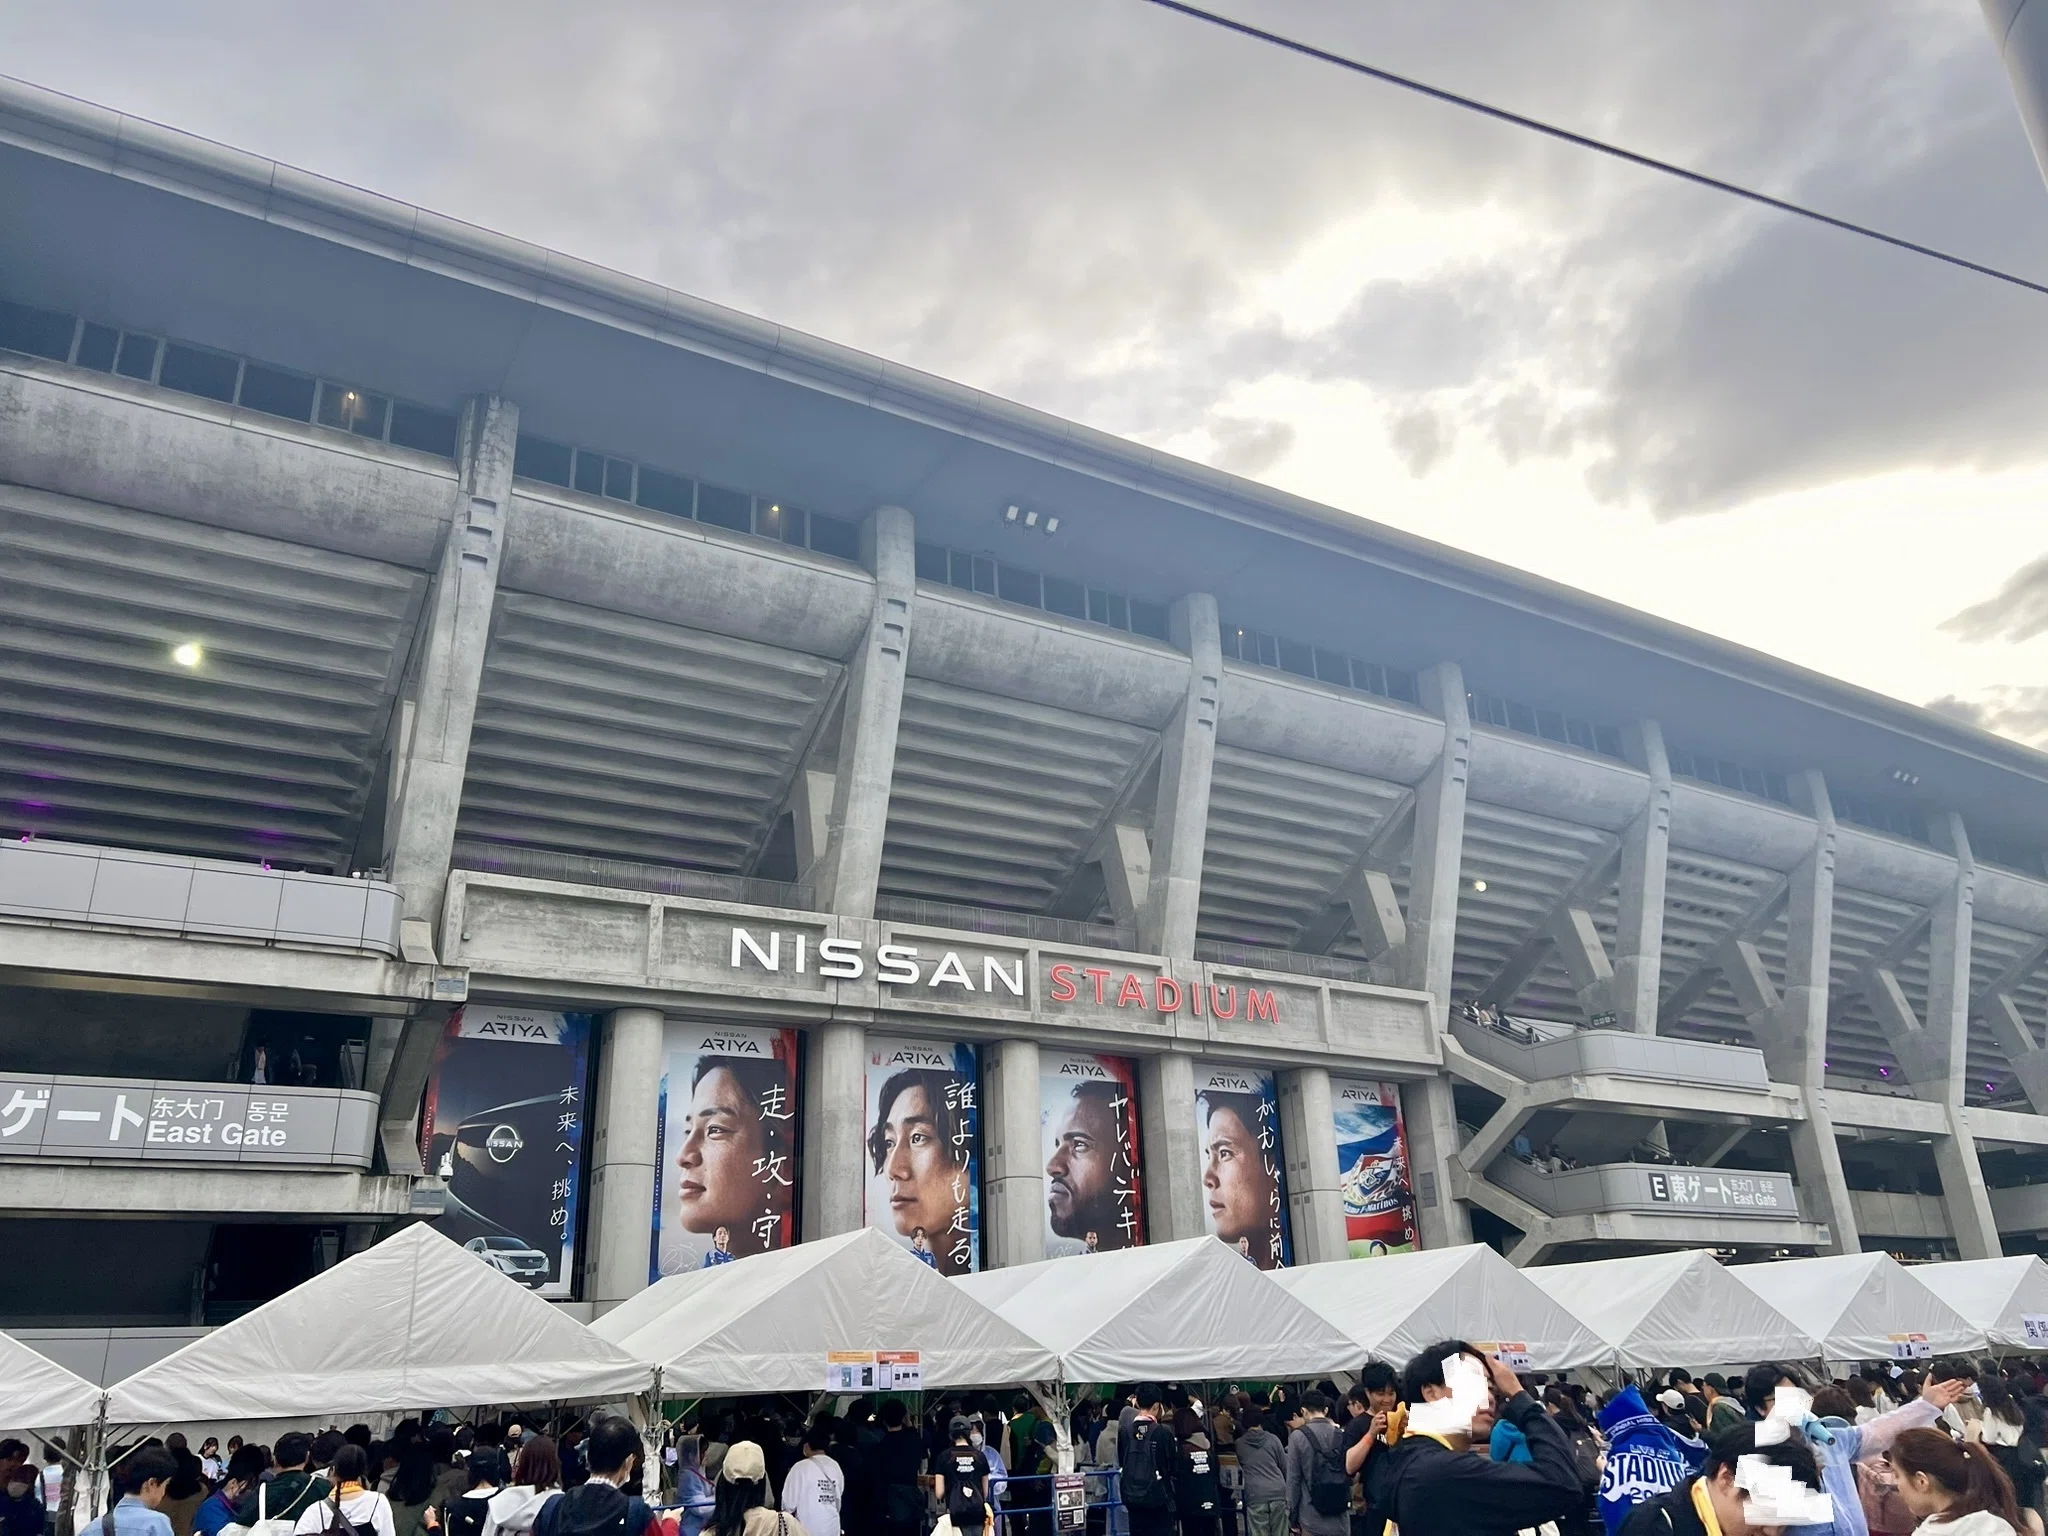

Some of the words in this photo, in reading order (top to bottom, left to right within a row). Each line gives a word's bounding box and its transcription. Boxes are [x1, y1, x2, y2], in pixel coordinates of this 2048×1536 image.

[730, 928, 1024, 996] NISSAN
[1050, 964, 1280, 1025] STADIUM
[496, 1013, 534, 1022] NISSAN
[477, 1021, 549, 1039] ARIYA
[699, 1038, 761, 1053] ARIYA
[892, 1051, 945, 1066] ARIYA
[1060, 1063, 1106, 1078] ARIYA
[1208, 1077, 1250, 1090] ARIYA
[1341, 1089, 1379, 1102] ARIYA
[1, 1089, 144, 1141] ゲート
[150, 1097, 224, 1121] 东大门
[247, 1101, 289, 1123] 동문
[147, 1120, 213, 1144] East
[220, 1122, 287, 1146] Gate
[486, 1138, 523, 1149] NISSAN
[550, 1085, 579, 1241] 未来へ、挑め。
[944, 1079, 978, 1268] 誰よりも走る。
[1108, 1093, 1140, 1250] ヤレバデキ
[1652, 1176, 1667, 1198] E
[1669, 1174, 1732, 1204] 東ゲート
[1733, 1192, 1755, 1205] East
[1755, 1193, 1777, 1207] Gate
